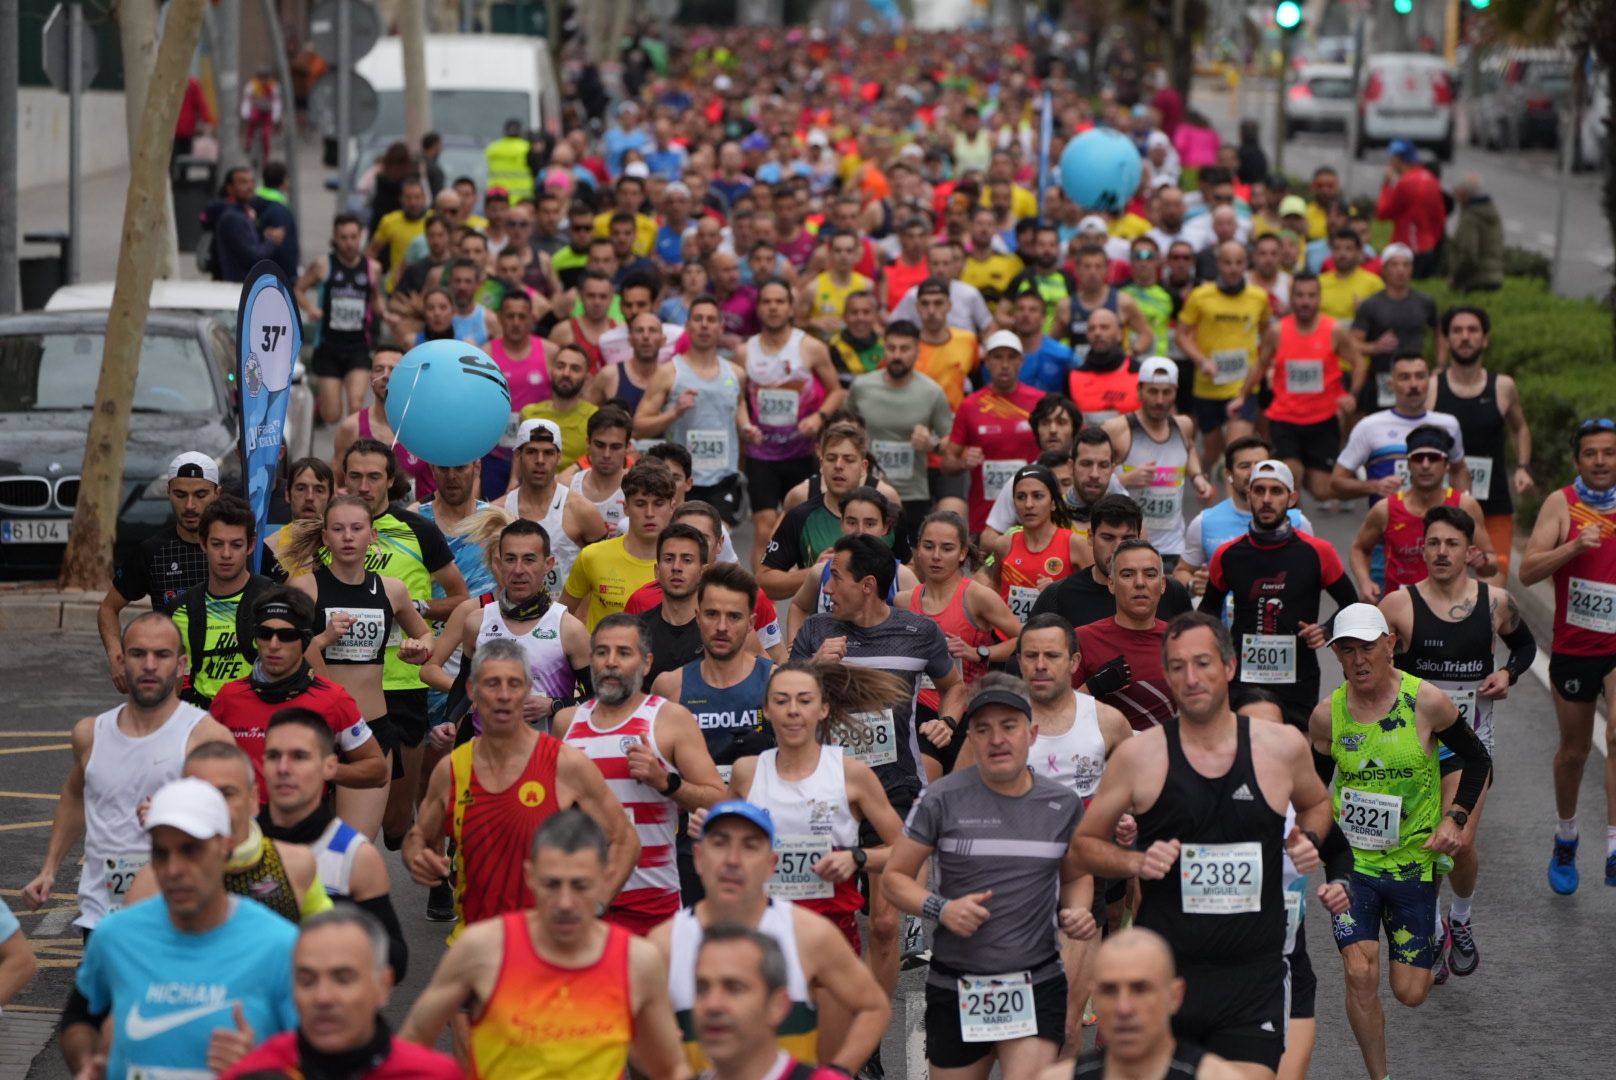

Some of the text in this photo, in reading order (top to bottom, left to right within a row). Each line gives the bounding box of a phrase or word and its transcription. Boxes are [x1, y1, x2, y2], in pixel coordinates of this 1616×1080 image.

[691, 441, 723, 454] 2343
[13, 522, 59, 539] 6104
[1572, 591, 1613, 613] 2423
[341, 621, 377, 640] 439
[1247, 648, 1287, 664] 2601
[840, 725, 887, 748] 2998
[1345, 804, 1390, 830] 2321
[1350, 825, 1383, 837] PEDROM
[774, 852, 821, 874] 579
[1190, 863, 1252, 885] 2382
[1203, 887, 1240, 895] MIGUEL
[968, 990, 1024, 1015] 2520
[983, 1015, 1012, 1024] MARIO
